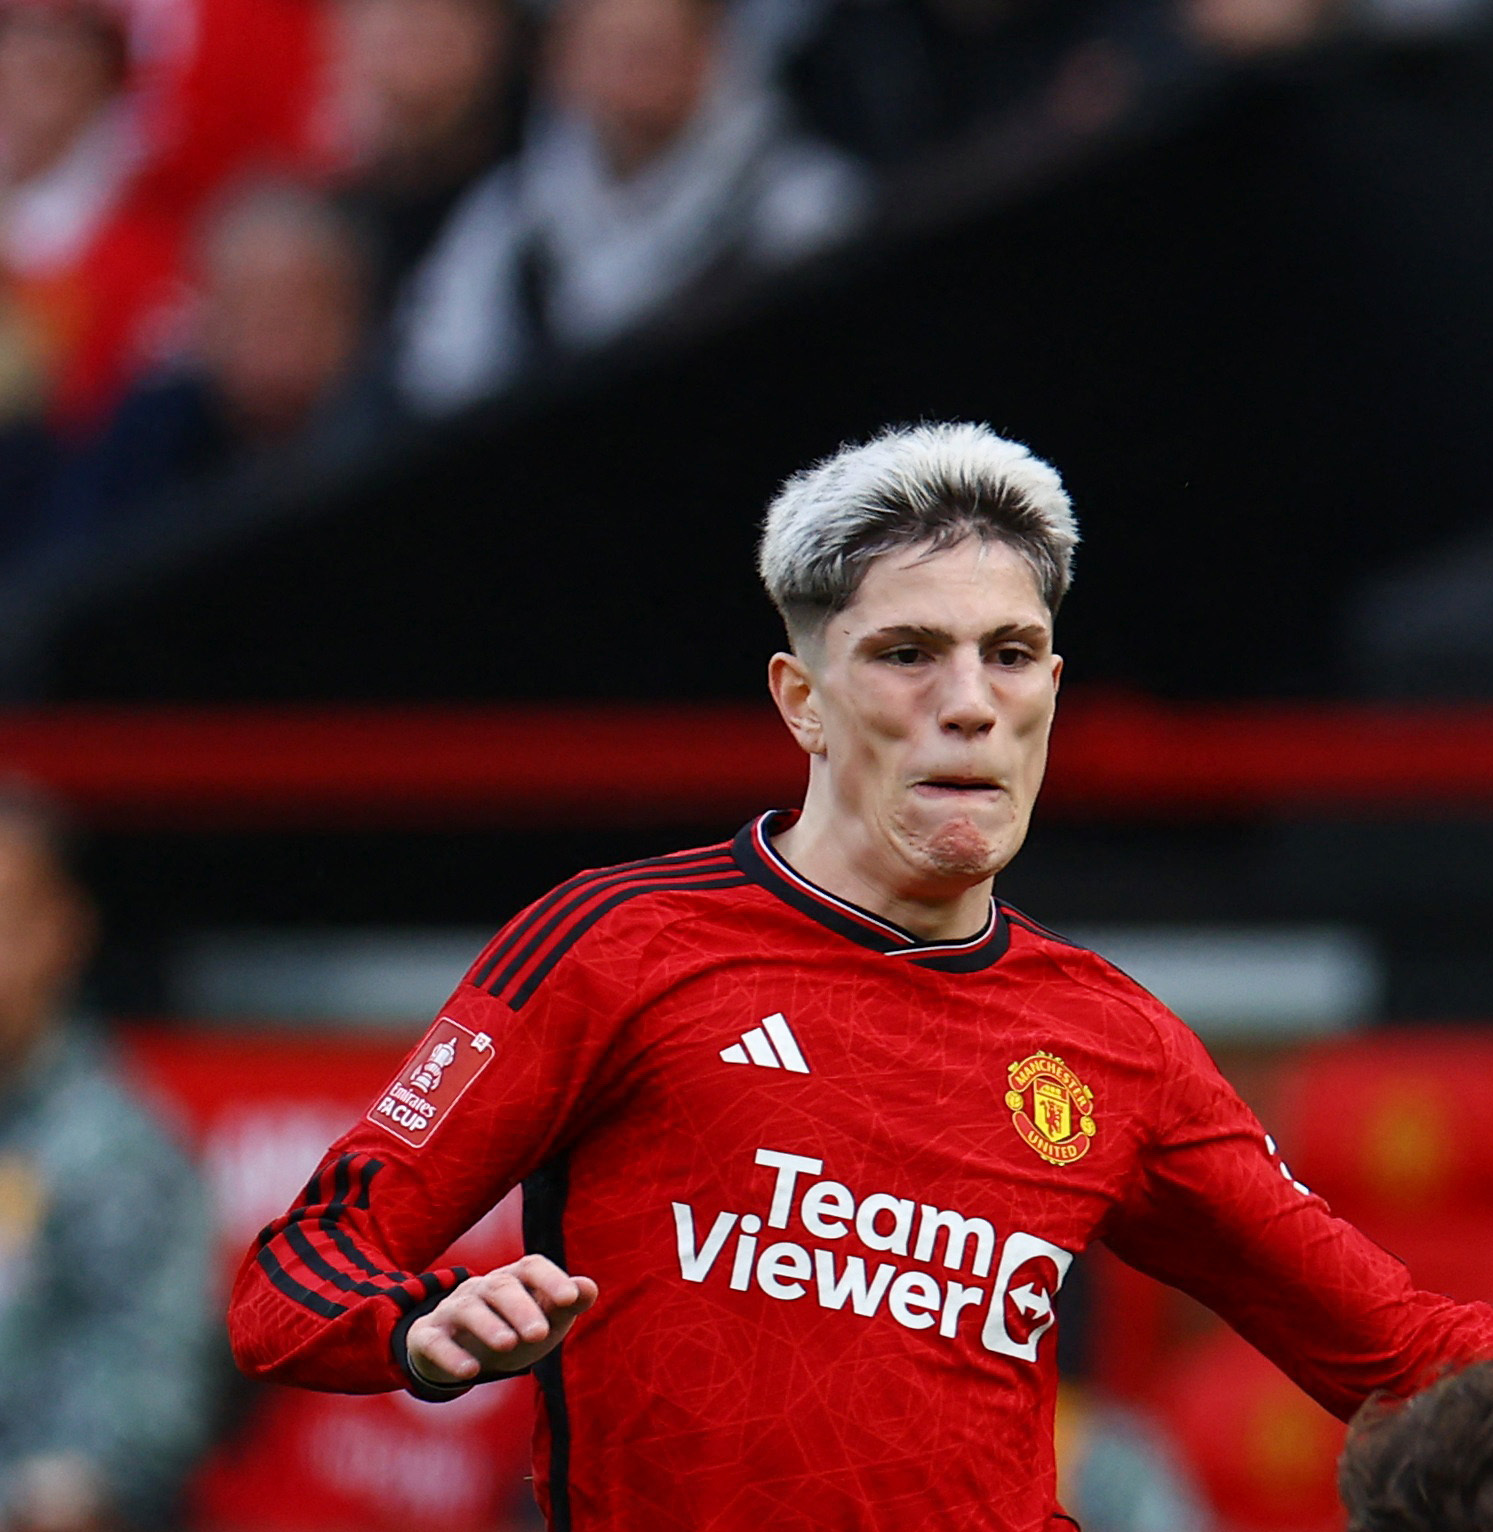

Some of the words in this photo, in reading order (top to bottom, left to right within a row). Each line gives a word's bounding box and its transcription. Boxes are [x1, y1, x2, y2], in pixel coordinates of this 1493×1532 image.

[389, 1081, 437, 1118] Emirates
[1015, 1060, 1087, 1107] MANCHESTER
[376, 1096, 396, 1116] FA
[391, 1104, 428, 1131] CUP
[1027, 1130, 1077, 1159] UNITED
[754, 1148, 997, 1279] Team
[671, 1201, 984, 1339] Viewer
